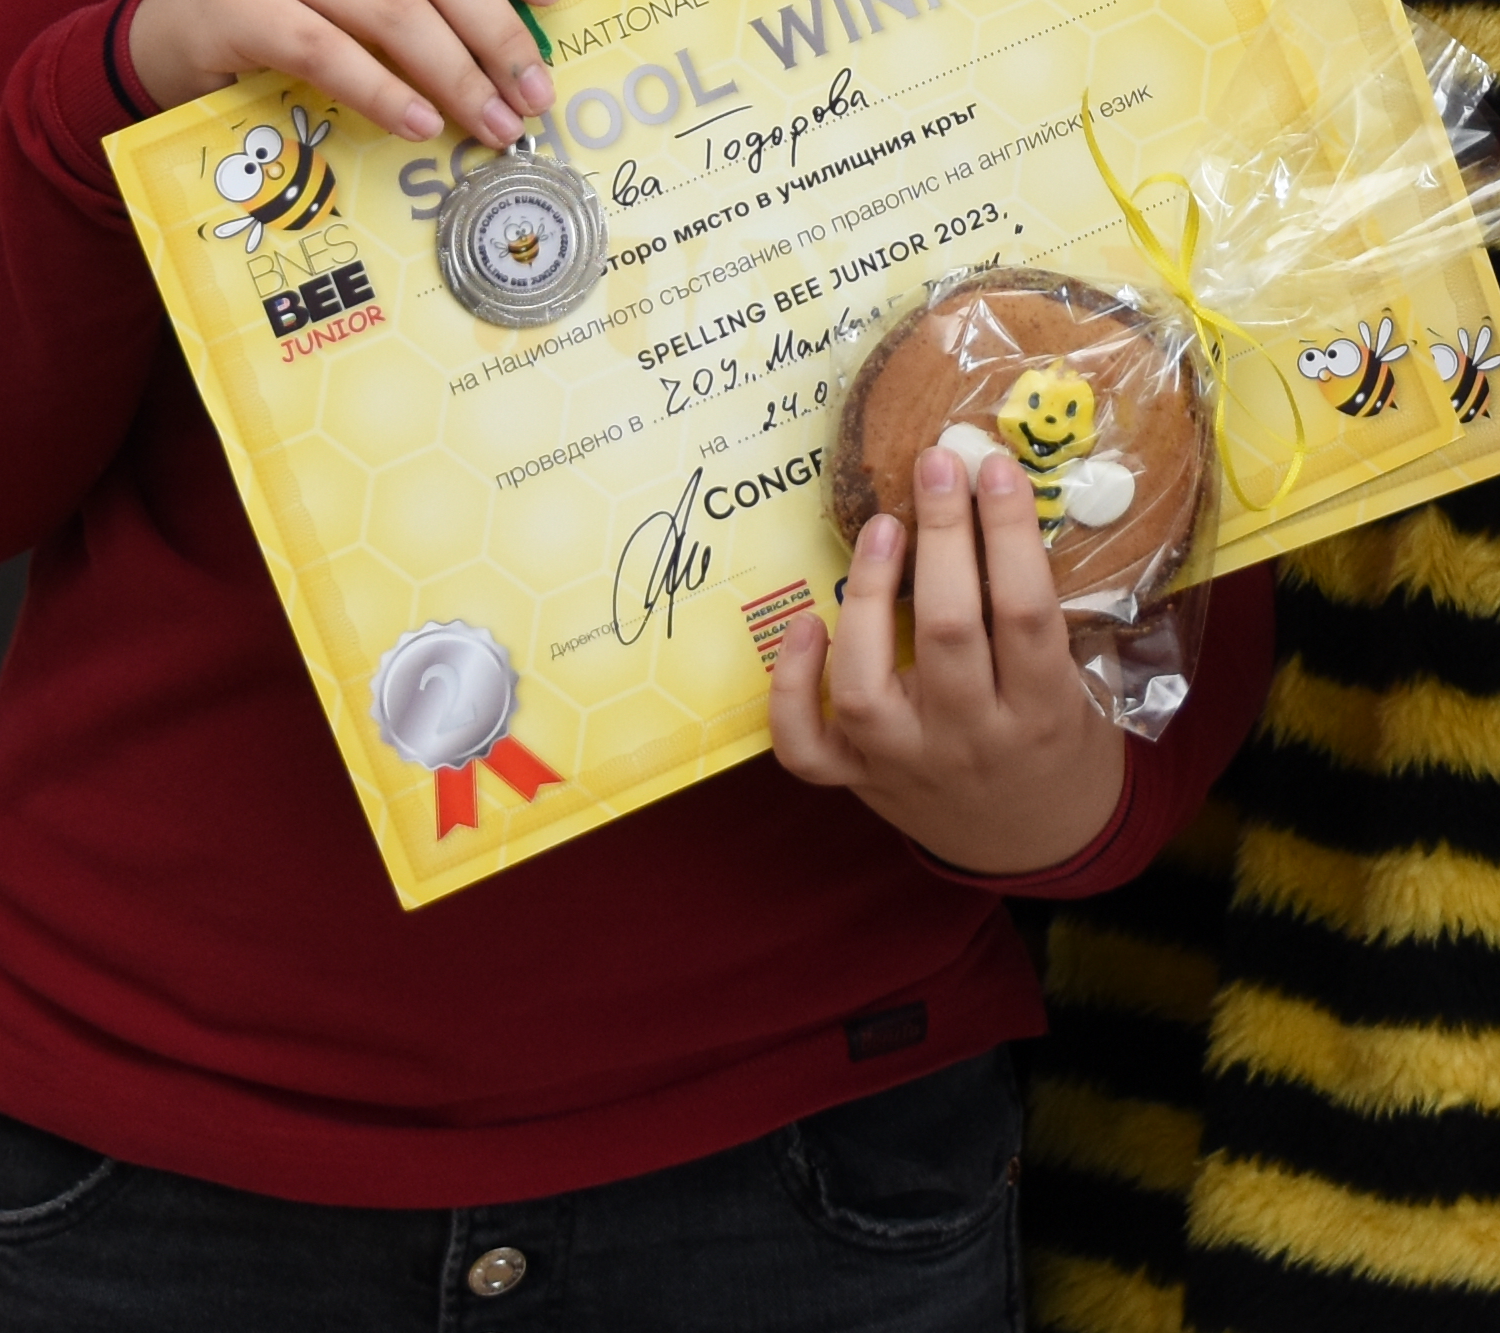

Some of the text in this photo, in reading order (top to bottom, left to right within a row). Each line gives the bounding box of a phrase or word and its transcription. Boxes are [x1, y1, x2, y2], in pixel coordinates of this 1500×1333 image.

[479, 195, 564, 234] SCHOOL RUNNER-UP
[600, 103, 979, 277] торо място в училищния кръг
[247, 223, 358, 298] BNES
[450, 85, 1153, 396] на Националното състезание по правопис на английски език
[478, 234, 569, 287] SPELLING BEE JUNIOR 2023
[262, 260, 375, 338] BEE
[638, 301, 766, 371] SPELLING
[773, 277, 823, 313] BEE
[829, 233, 929, 290] JUNIOR
[934, 202, 1009, 245] 2023,
[281, 305, 386, 363] JUNIOR
[495, 414, 645, 490] проведено в
[699, 435, 729, 459] на
[746, 588, 811, 623] AMERICA FOR
